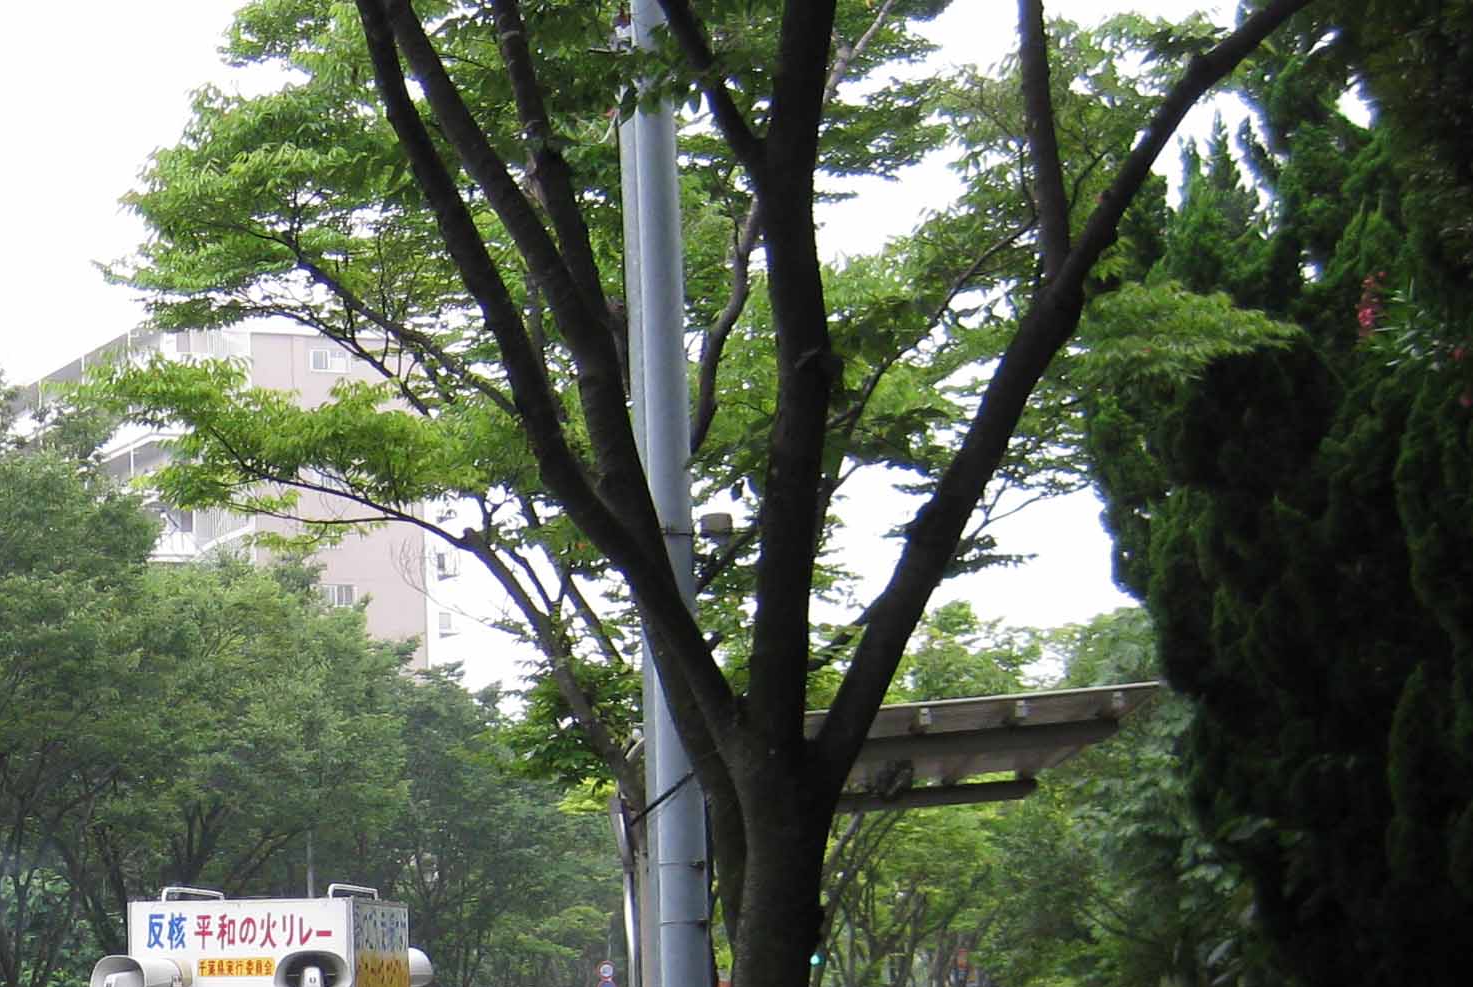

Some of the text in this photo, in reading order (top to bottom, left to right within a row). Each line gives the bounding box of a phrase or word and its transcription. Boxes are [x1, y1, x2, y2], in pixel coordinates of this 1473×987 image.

[147, 912, 187, 950] 反核
[194, 912, 332, 950] 平和の火リレー
[199, 960, 272, 976] 千葉県実行委員会
